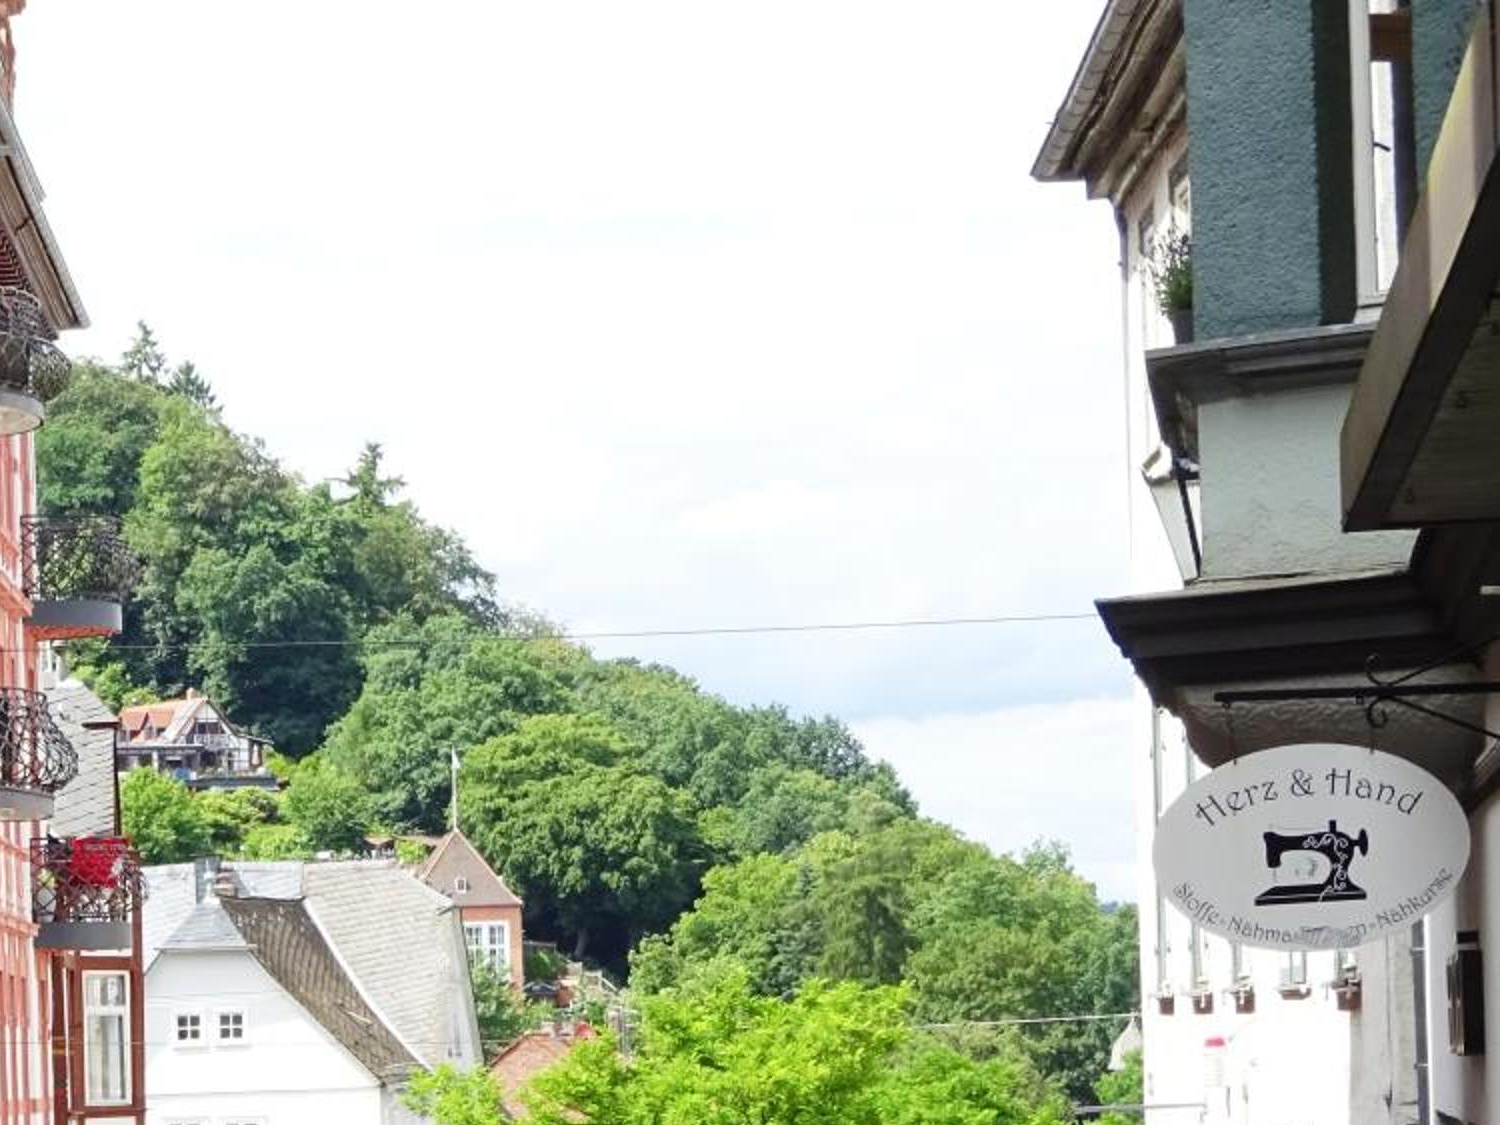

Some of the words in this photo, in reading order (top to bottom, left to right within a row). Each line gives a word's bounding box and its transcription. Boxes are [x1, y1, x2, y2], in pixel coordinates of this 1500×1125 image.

[1195, 780, 1278, 828] Herz
[1290, 768, 1315, 798] &
[1324, 767, 1424, 816] Hand
